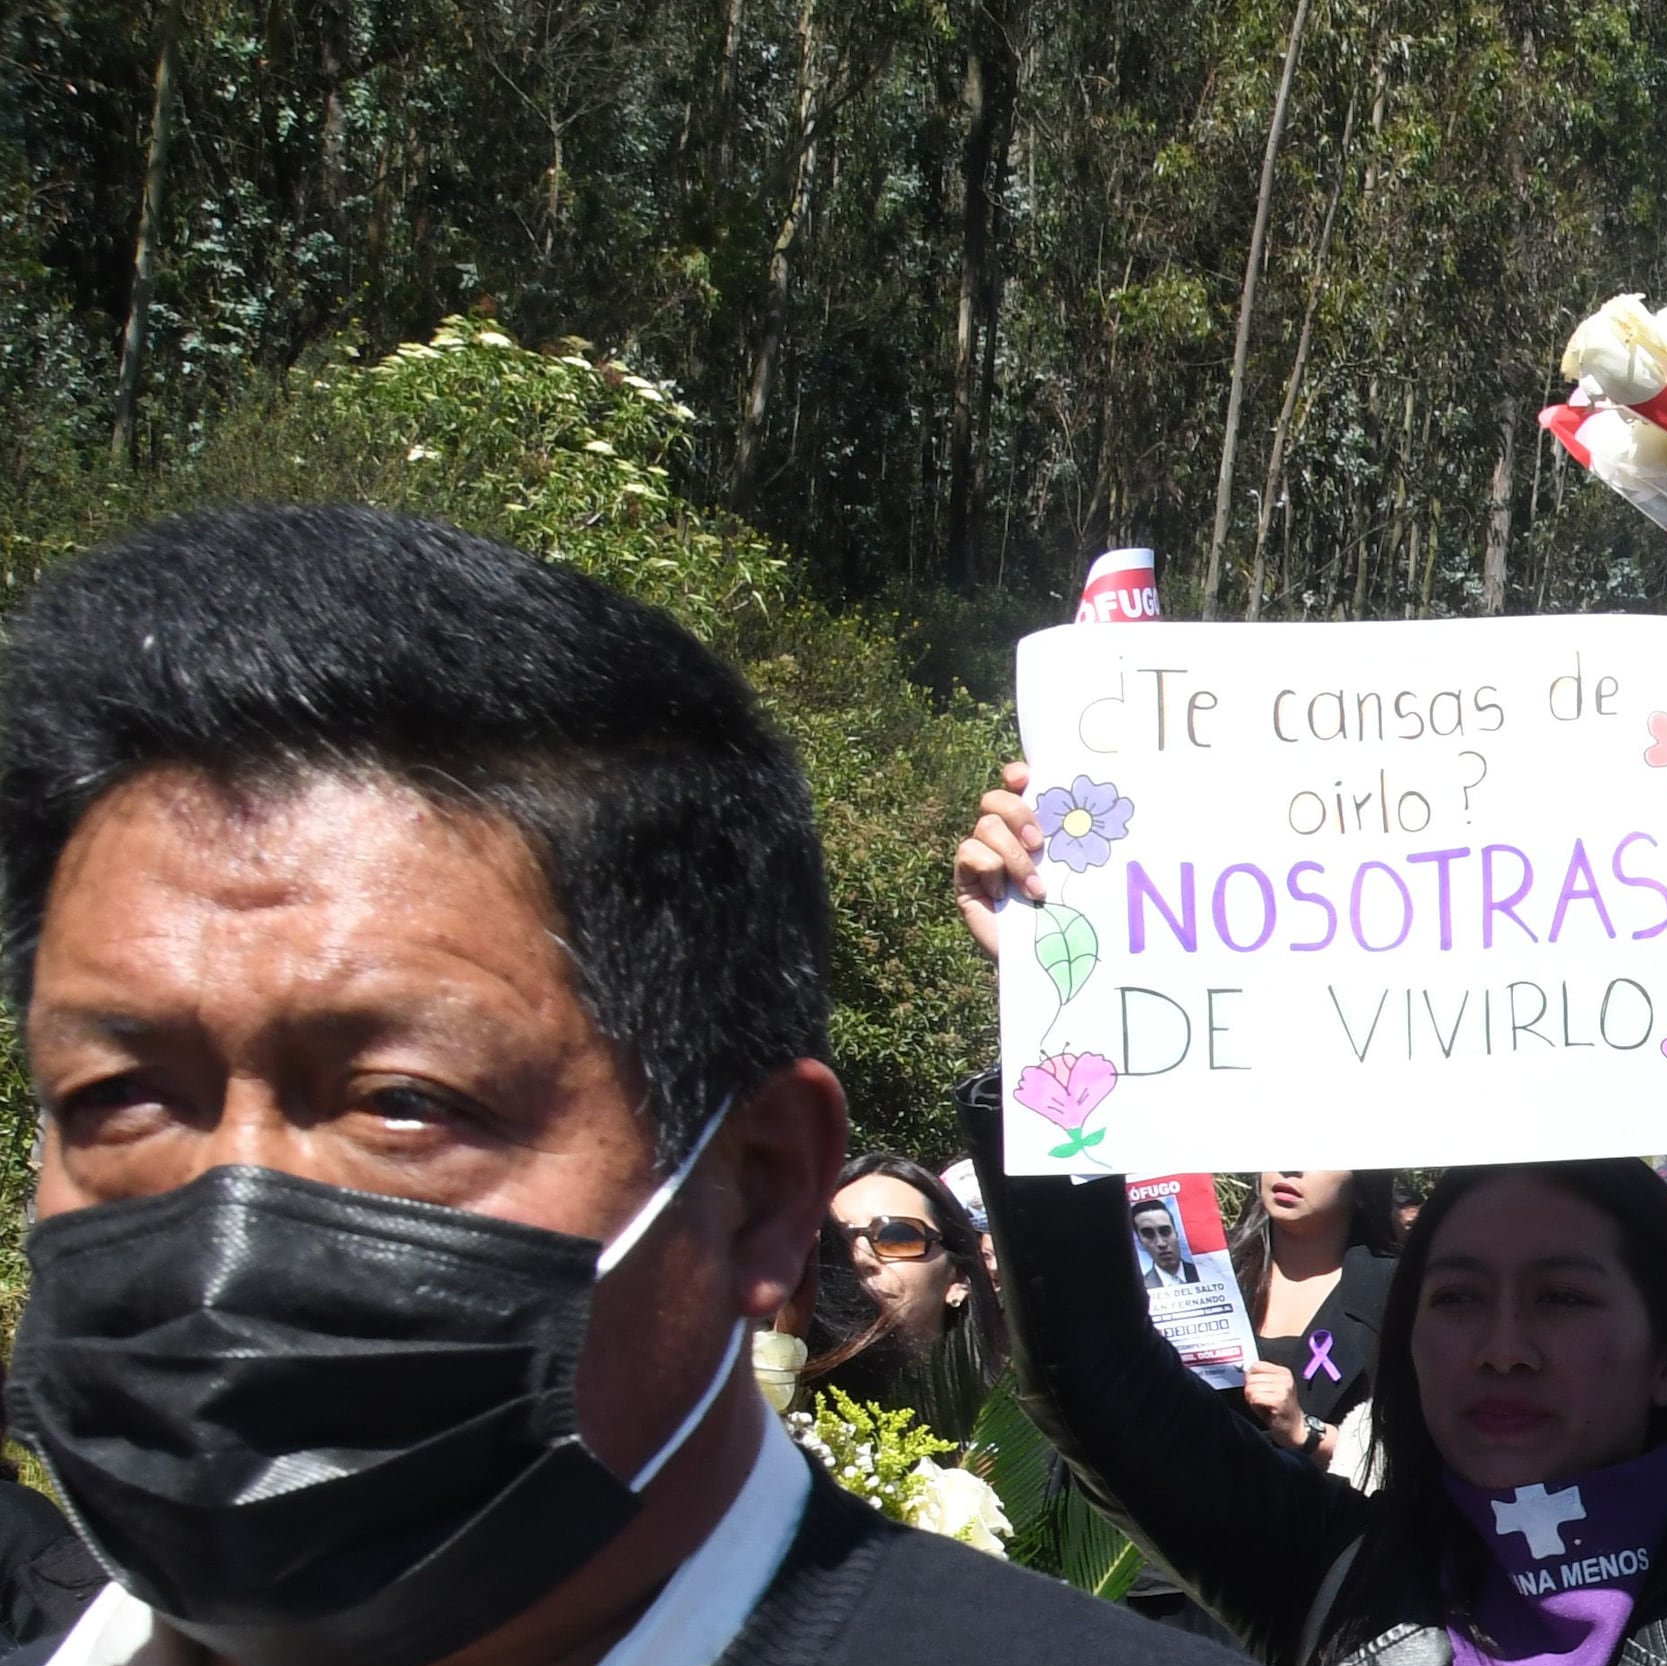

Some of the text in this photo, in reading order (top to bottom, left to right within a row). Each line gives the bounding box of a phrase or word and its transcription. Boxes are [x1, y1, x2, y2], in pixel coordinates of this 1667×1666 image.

[1272, 681, 1506, 745] cansas
[1549, 651, 1621, 722] de
[1112, 977, 1654, 1077] DE VIVIRLO
[1560, 1547, 1651, 1589] MENOS
